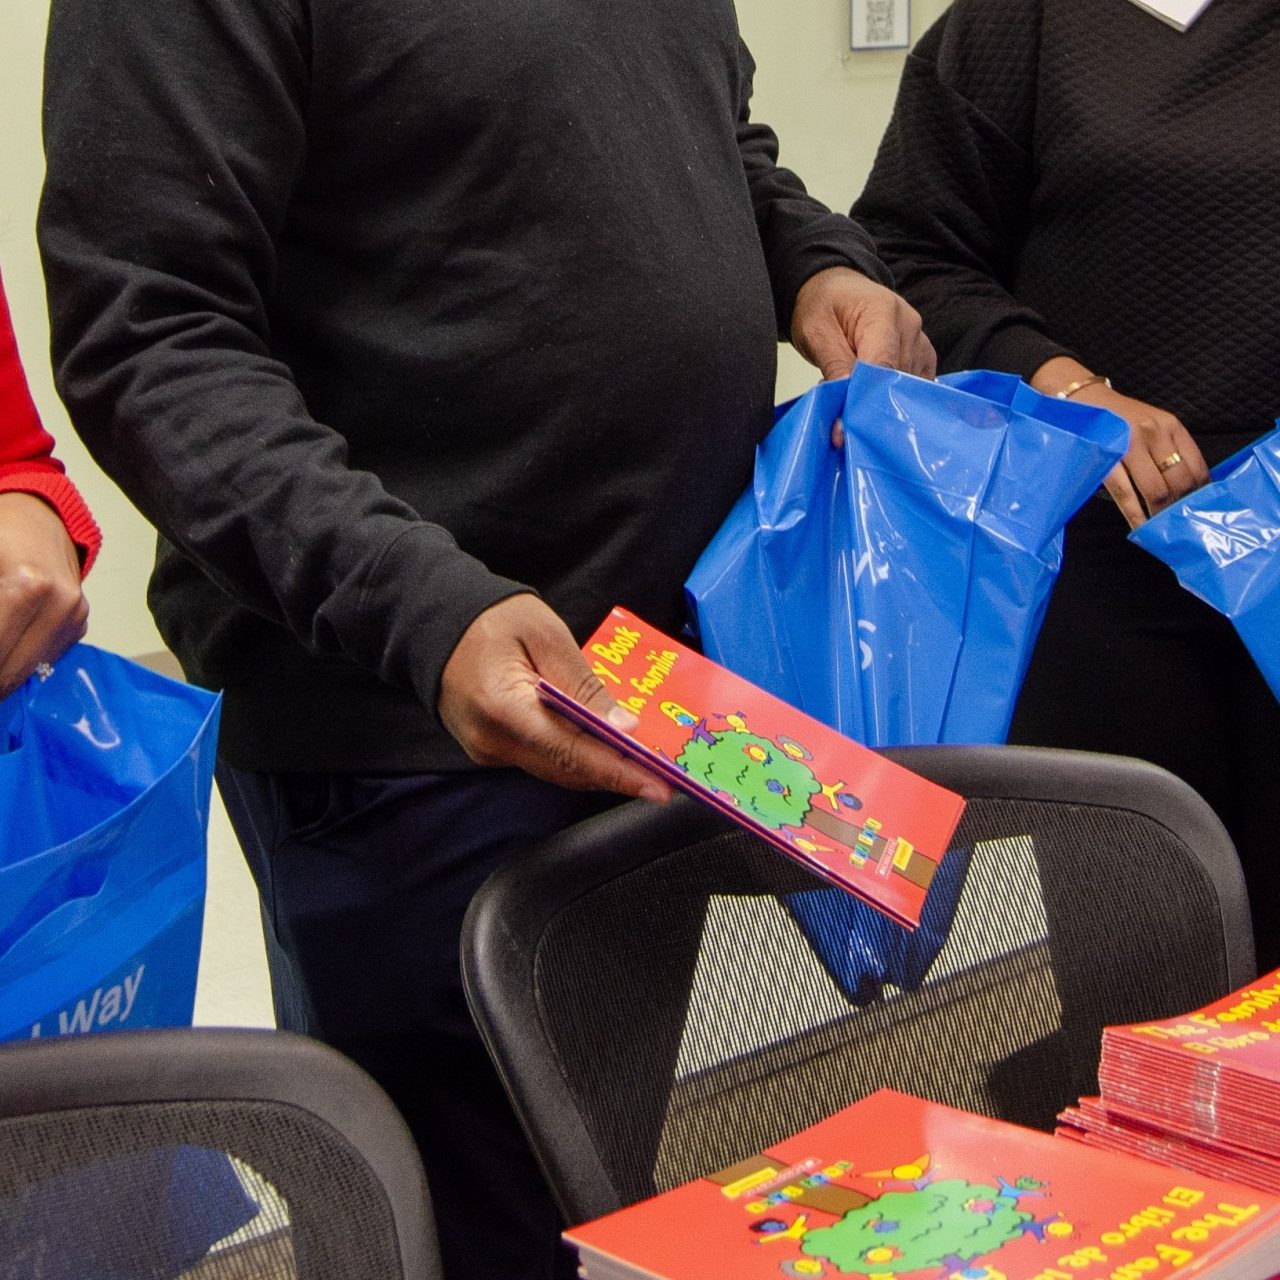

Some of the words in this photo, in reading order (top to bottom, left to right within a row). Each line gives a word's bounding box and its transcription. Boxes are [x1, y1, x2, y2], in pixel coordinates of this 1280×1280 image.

[590, 625, 642, 666] Book
[629, 649, 680, 697] familia
[59, 964, 146, 1035] Way
[1131, 1024, 1208, 1040] The
[1182, 1041, 1220, 1054] El
[1207, 1031, 1271, 1049] libro
[1162, 1186, 1205, 1208] El
[1100, 1205, 1176, 1246] libro
[1170, 1202, 1261, 1242] The
[1056, 1246, 1108, 1268] de
